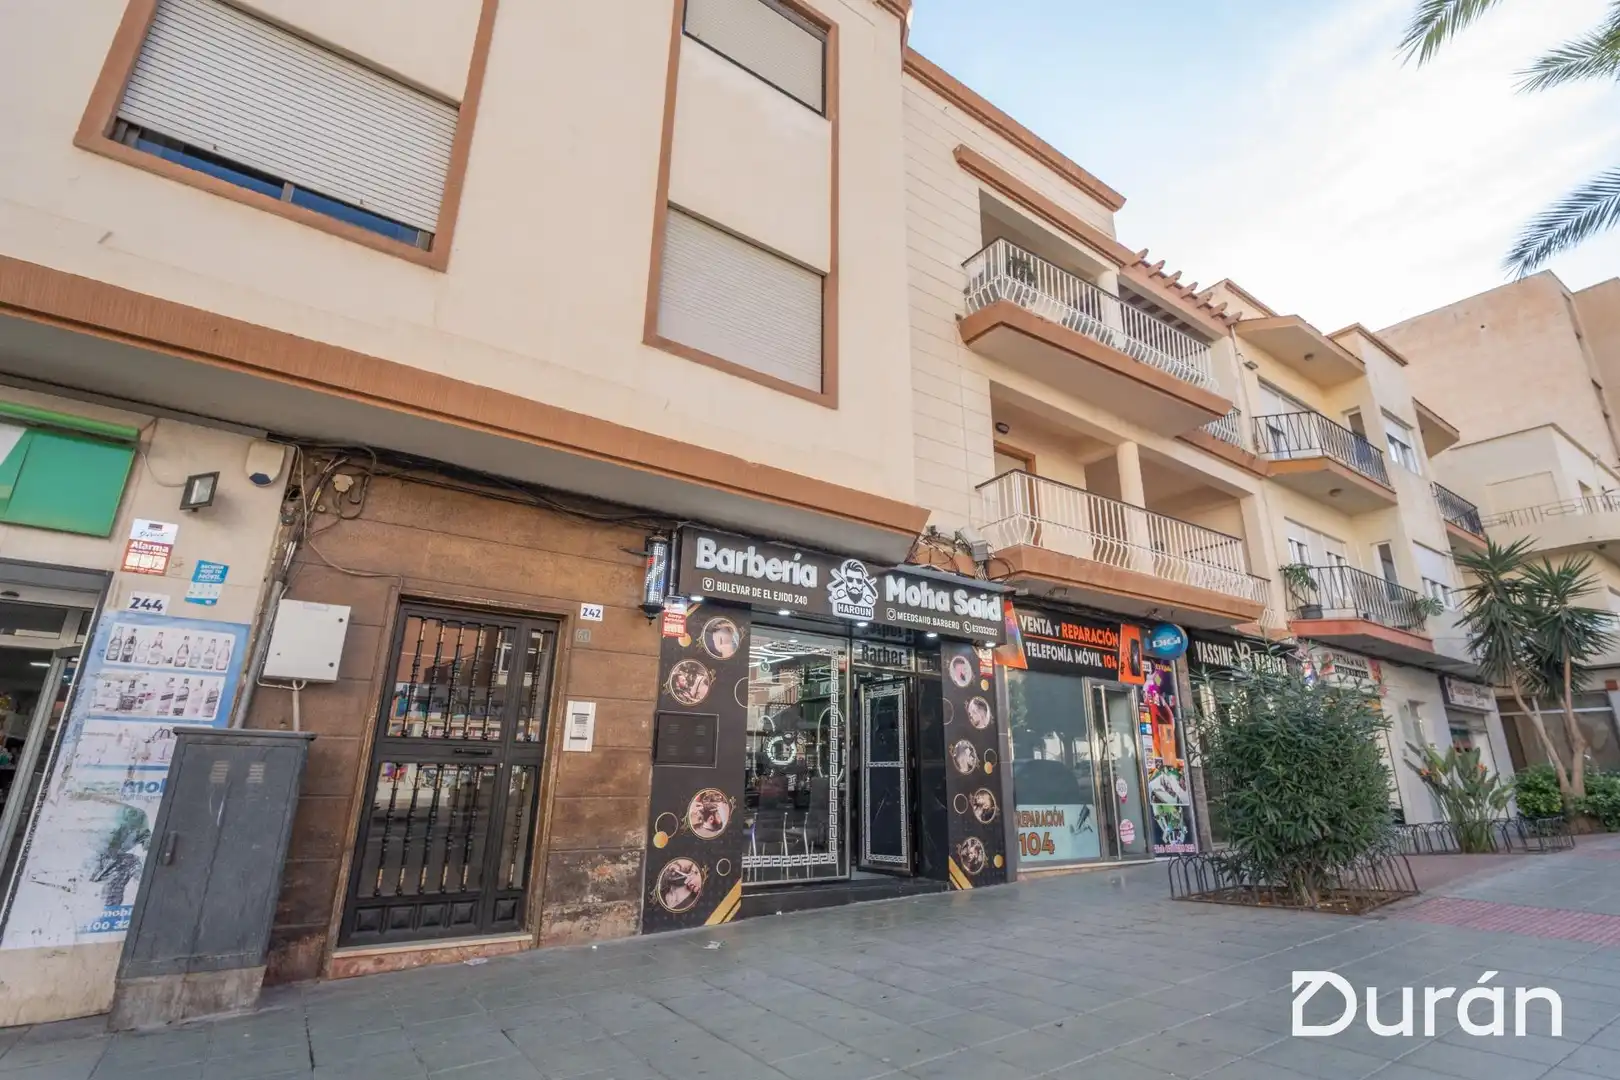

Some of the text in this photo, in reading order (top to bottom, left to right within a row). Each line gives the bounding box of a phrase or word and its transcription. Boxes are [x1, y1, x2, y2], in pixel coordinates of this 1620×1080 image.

[131, 541, 169, 553] Alarma
[696, 537, 818, 588] Barbería
[129, 596, 163, 612] 244
[716, 581, 808, 605] BULEVAR DE EL EJIDO 240
[885, 574, 1002, 622] Moha Said
[582, 607, 601, 618] 242
[837, 602, 872, 618] HAROUN
[1019, 614, 1053, 637] VENTA
[1061, 621, 1119, 647] REPARACIÓN
[1152, 637, 1181, 648] DIGI
[1026, 642, 1118, 670] TELEFONÍA MÓVIL 104
[1019, 832, 1056, 856] 104
